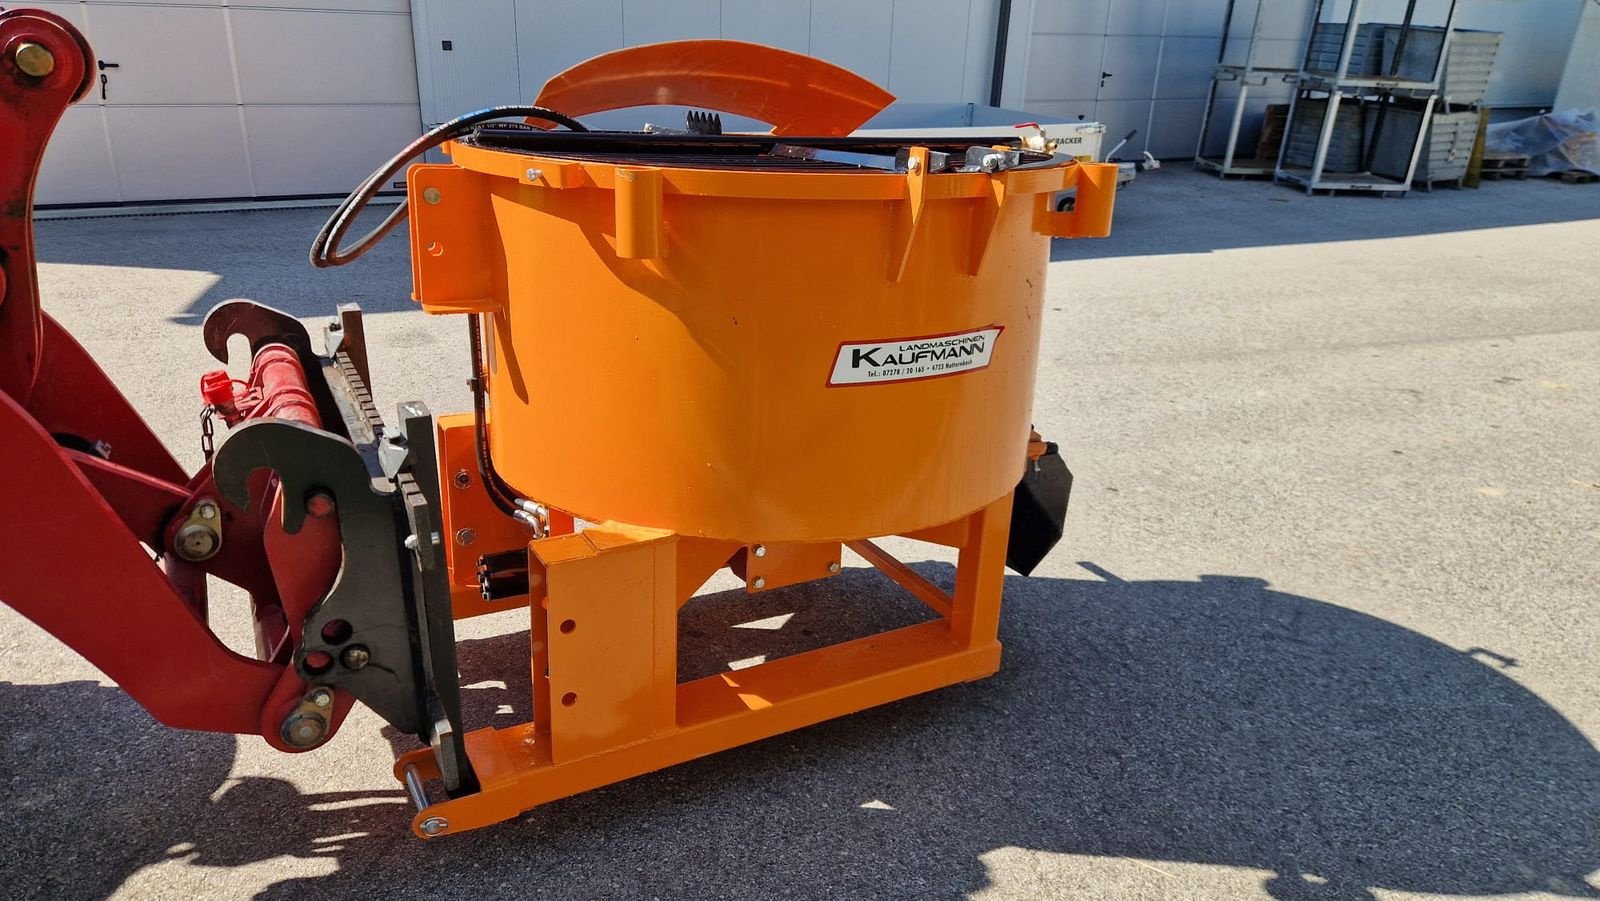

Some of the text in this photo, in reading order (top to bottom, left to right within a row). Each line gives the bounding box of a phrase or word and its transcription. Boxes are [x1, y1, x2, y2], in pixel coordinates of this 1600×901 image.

[899, 335, 985, 352] LANDMASCHINEN
[851, 342, 985, 369] KAUFMANN
[882, 368, 900, 376] 07278
[906, 367, 914, 375] 20
[915, 366, 925, 374] 165
[932, 363, 944, 371] 4723
